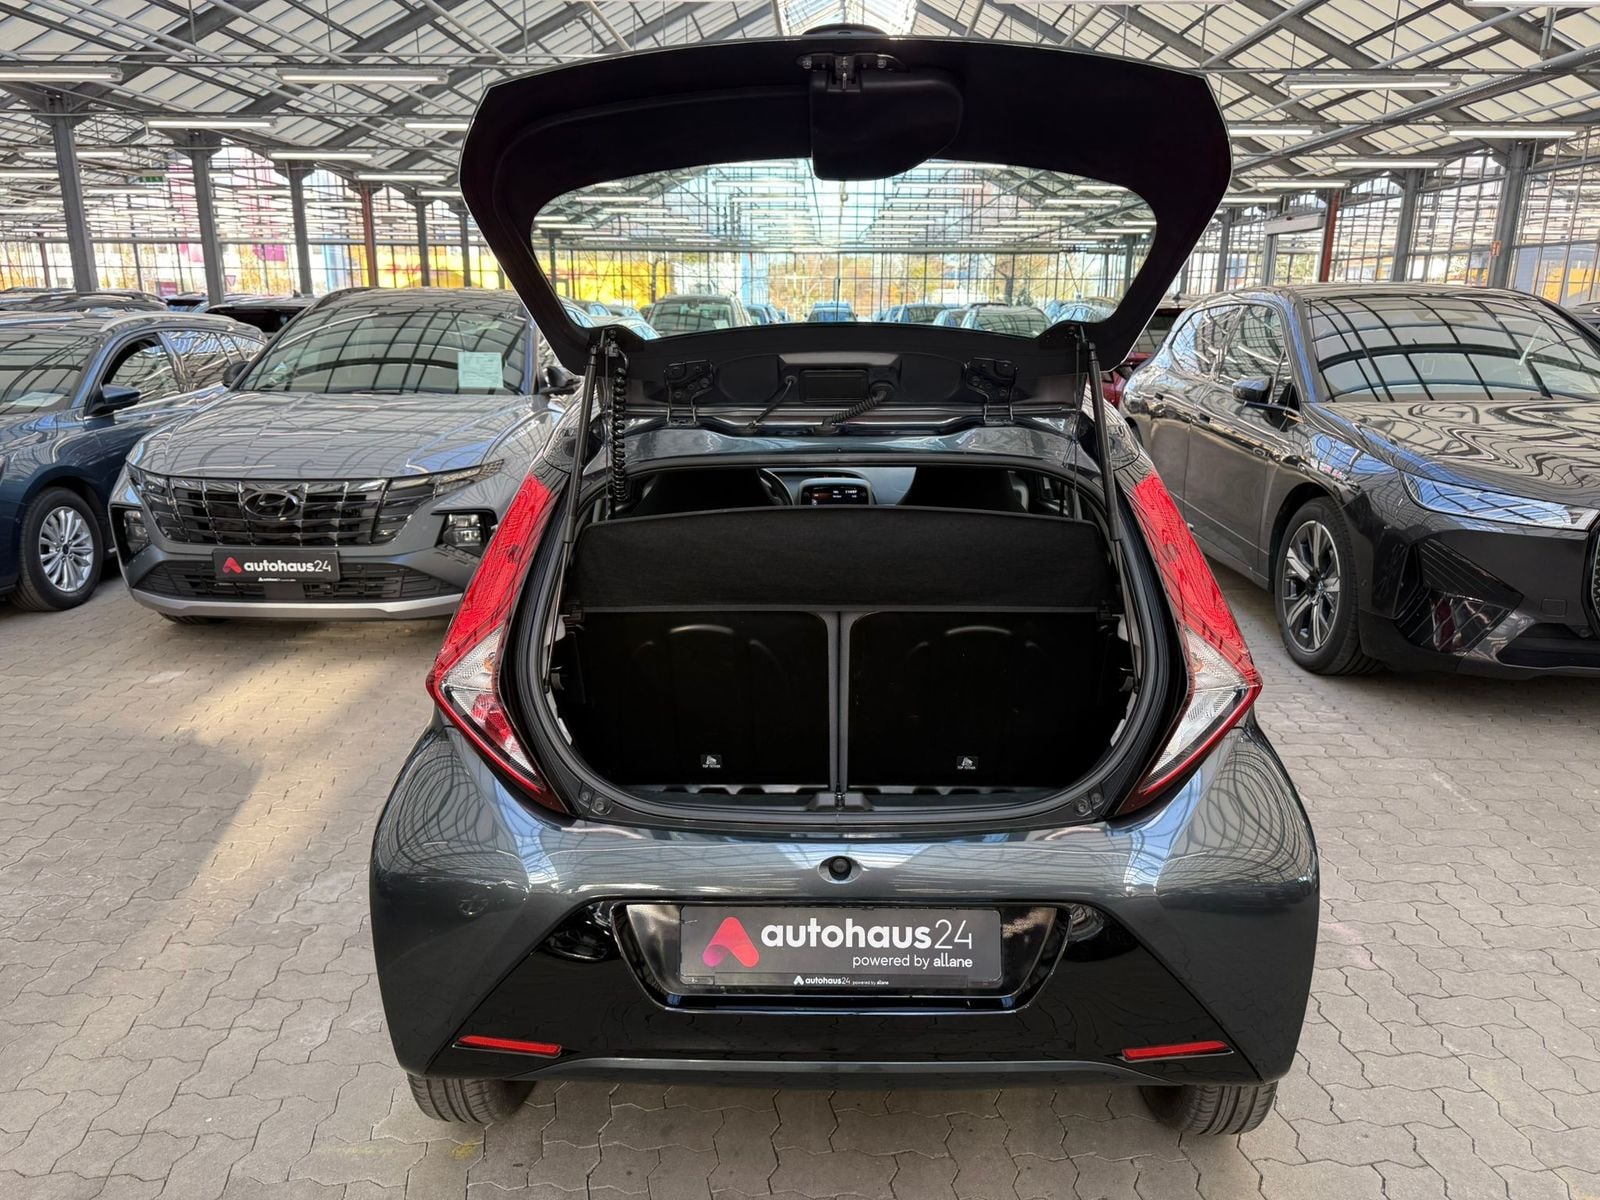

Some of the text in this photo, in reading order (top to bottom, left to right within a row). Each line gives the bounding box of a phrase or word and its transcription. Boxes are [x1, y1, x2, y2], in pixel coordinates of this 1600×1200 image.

[243, 559, 332, 572] autohaus24
[760, 917, 973, 950] autohaus24
[852, 952, 973, 969] powered by allane
[805, 976, 851, 985] autohaus24
